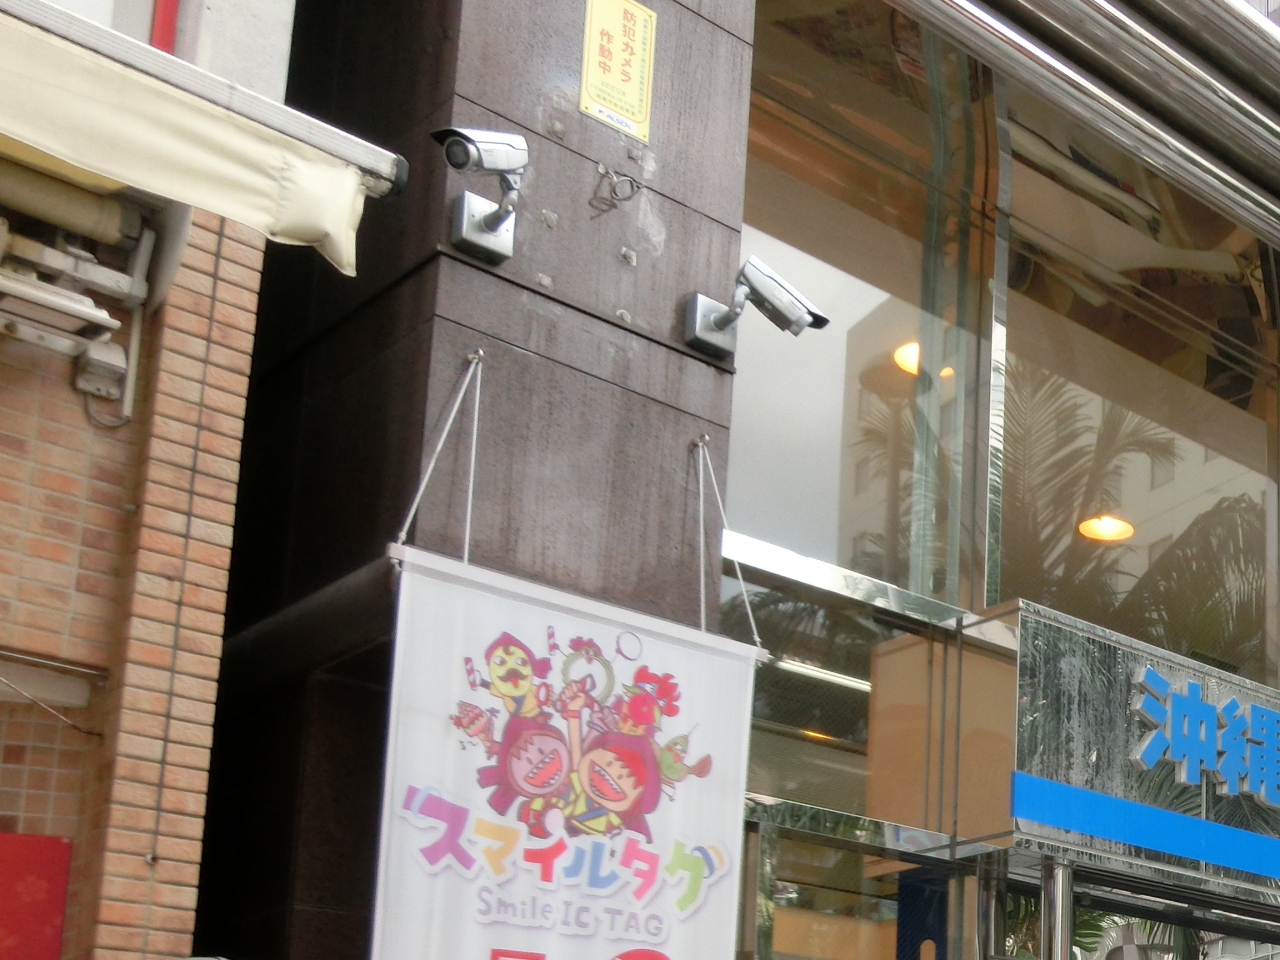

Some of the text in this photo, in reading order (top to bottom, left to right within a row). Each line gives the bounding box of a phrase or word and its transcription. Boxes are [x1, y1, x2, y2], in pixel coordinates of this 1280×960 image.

[598, 28, 614, 75] 作動中
[620, 8, 638, 83] 防犯カメラ
[477, 886, 664, 937] Smile IC TAG
